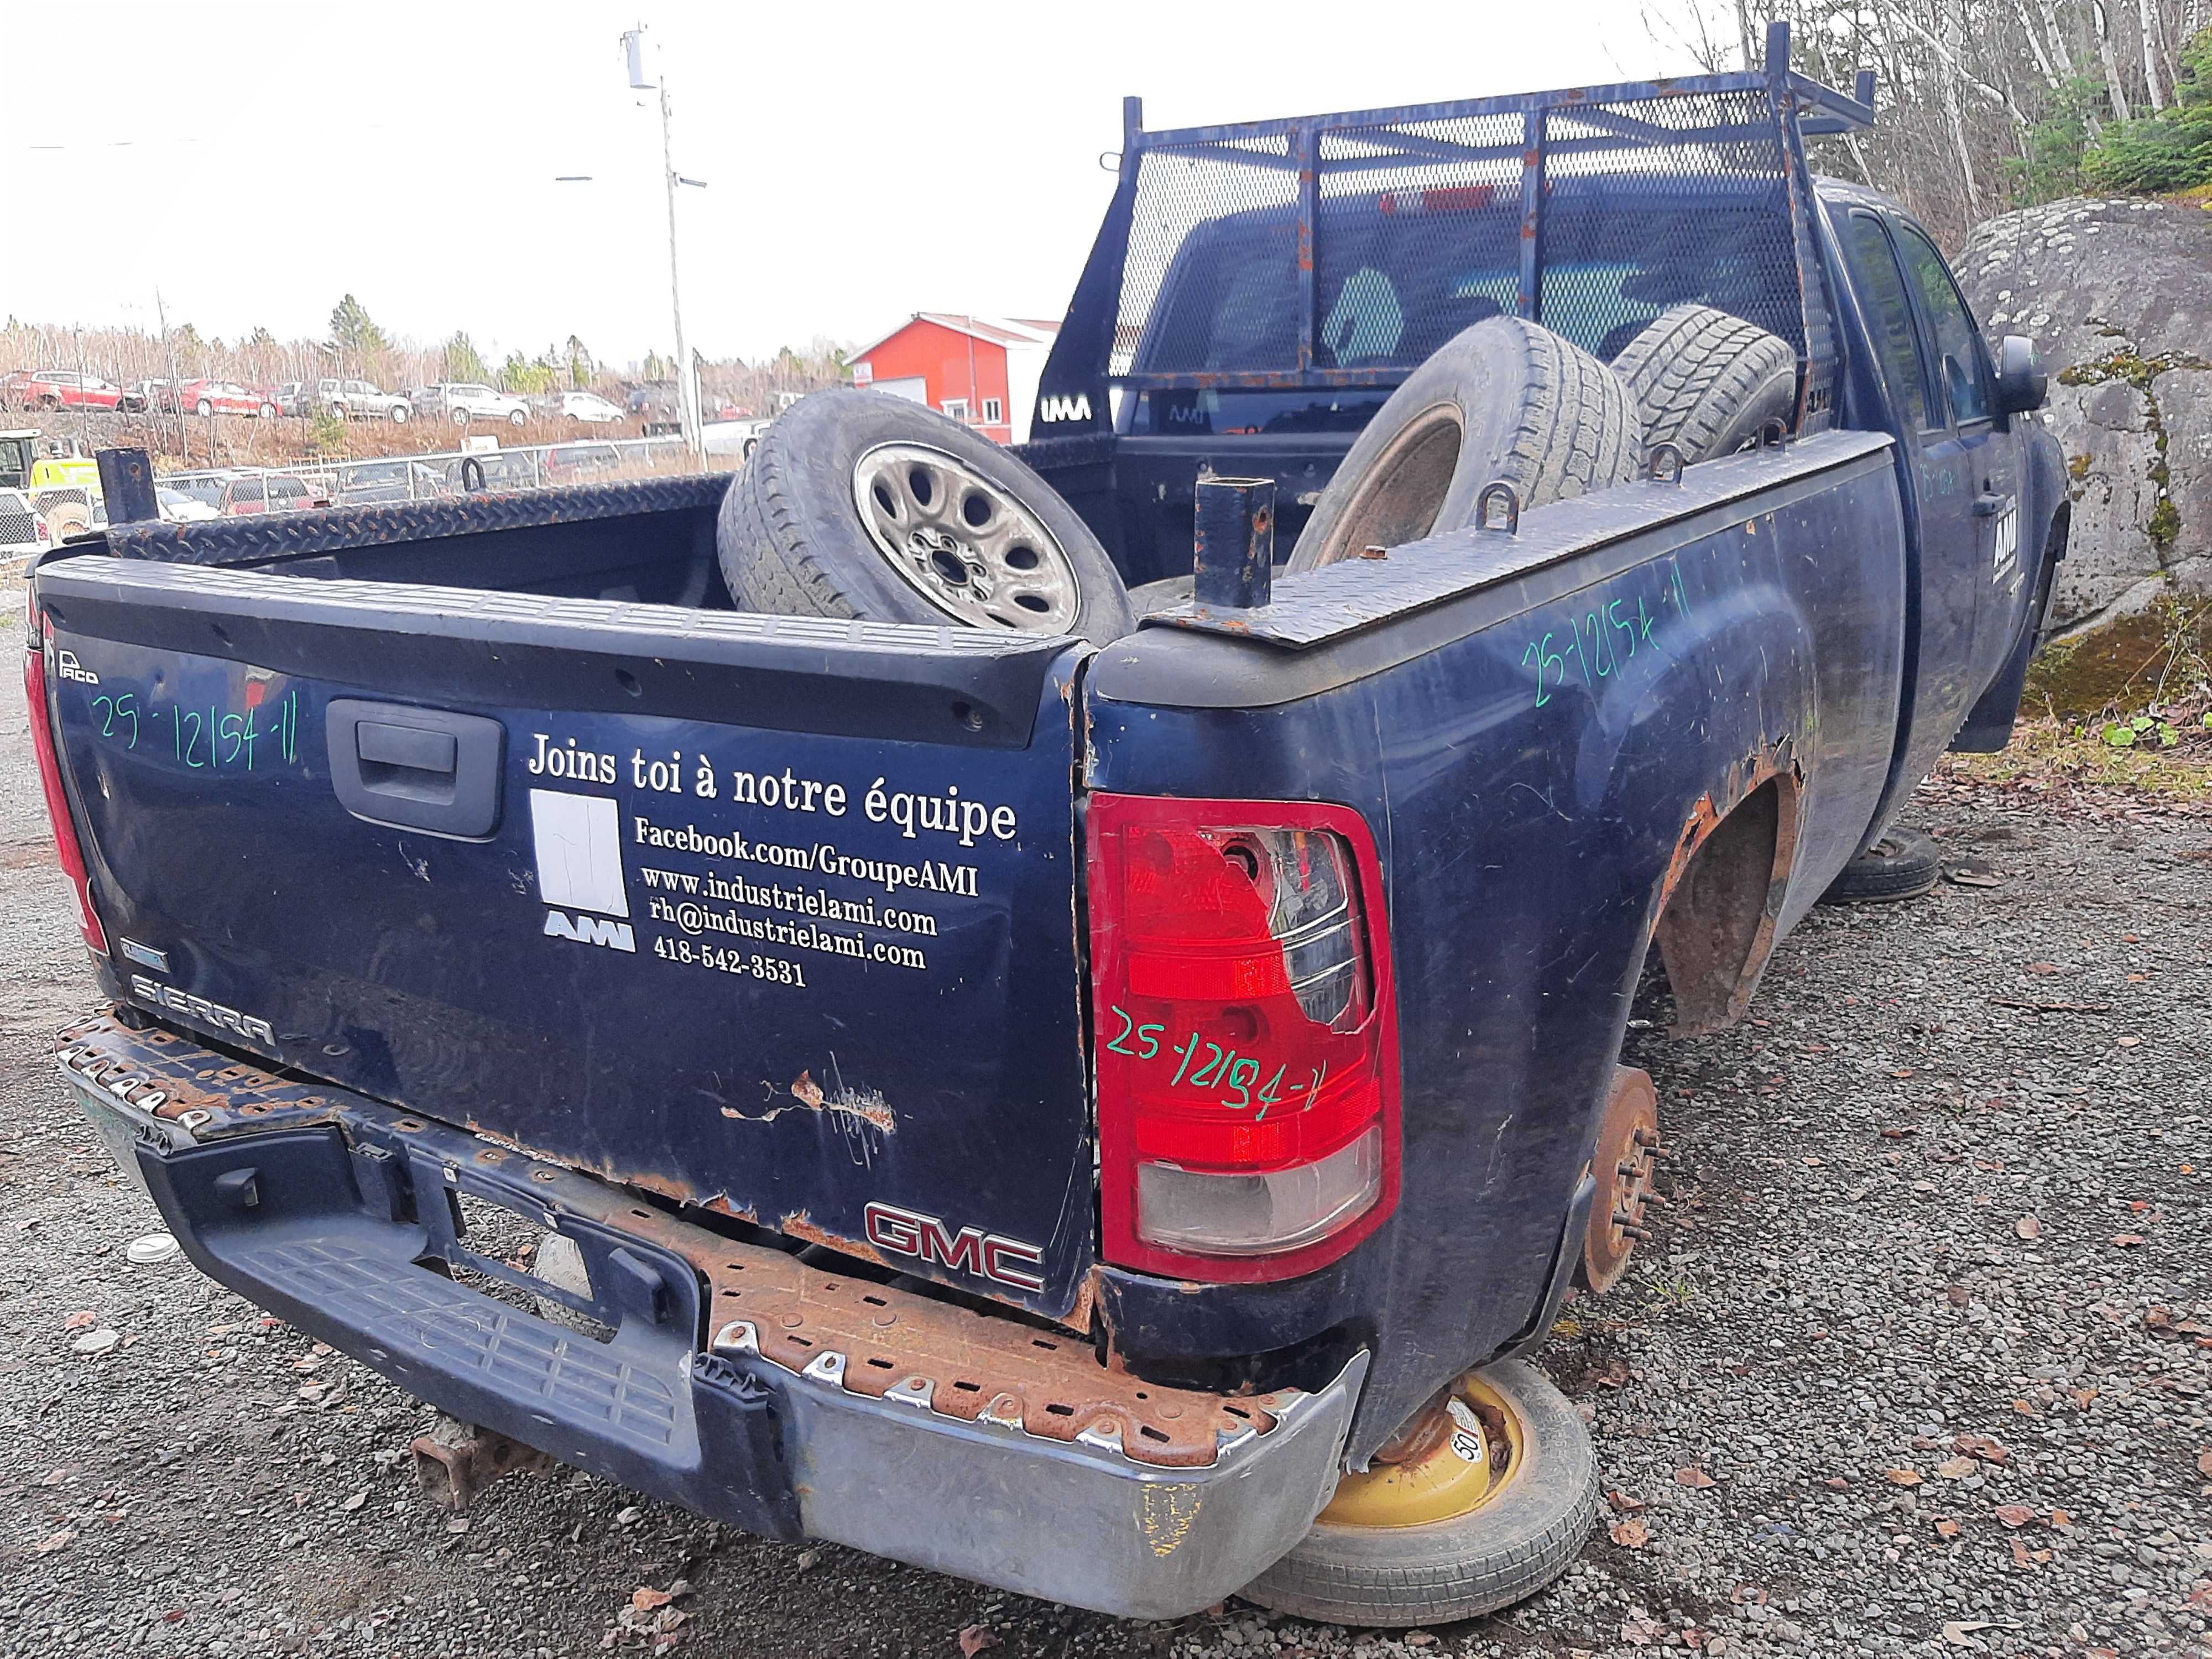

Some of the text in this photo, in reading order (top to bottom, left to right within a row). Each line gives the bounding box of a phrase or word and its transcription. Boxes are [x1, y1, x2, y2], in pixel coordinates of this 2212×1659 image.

[1993, 509, 2017, 569] AMI
[529, 733, 1016, 847] Joins toi à notre équipe
[634, 817, 979, 896] Facebook.com/GroupeAMI
[544, 910, 636, 953] AMI
[640, 868, 938, 936] www.industrielami.com
[649, 897, 926, 969] rh@industrielami.com
[654, 936, 806, 987] 418-542-3531
[131, 973, 276, 1046] SIERRA
[864, 1201, 1045, 1294] GMC
[1453, 1433, 1479, 1460] 50
